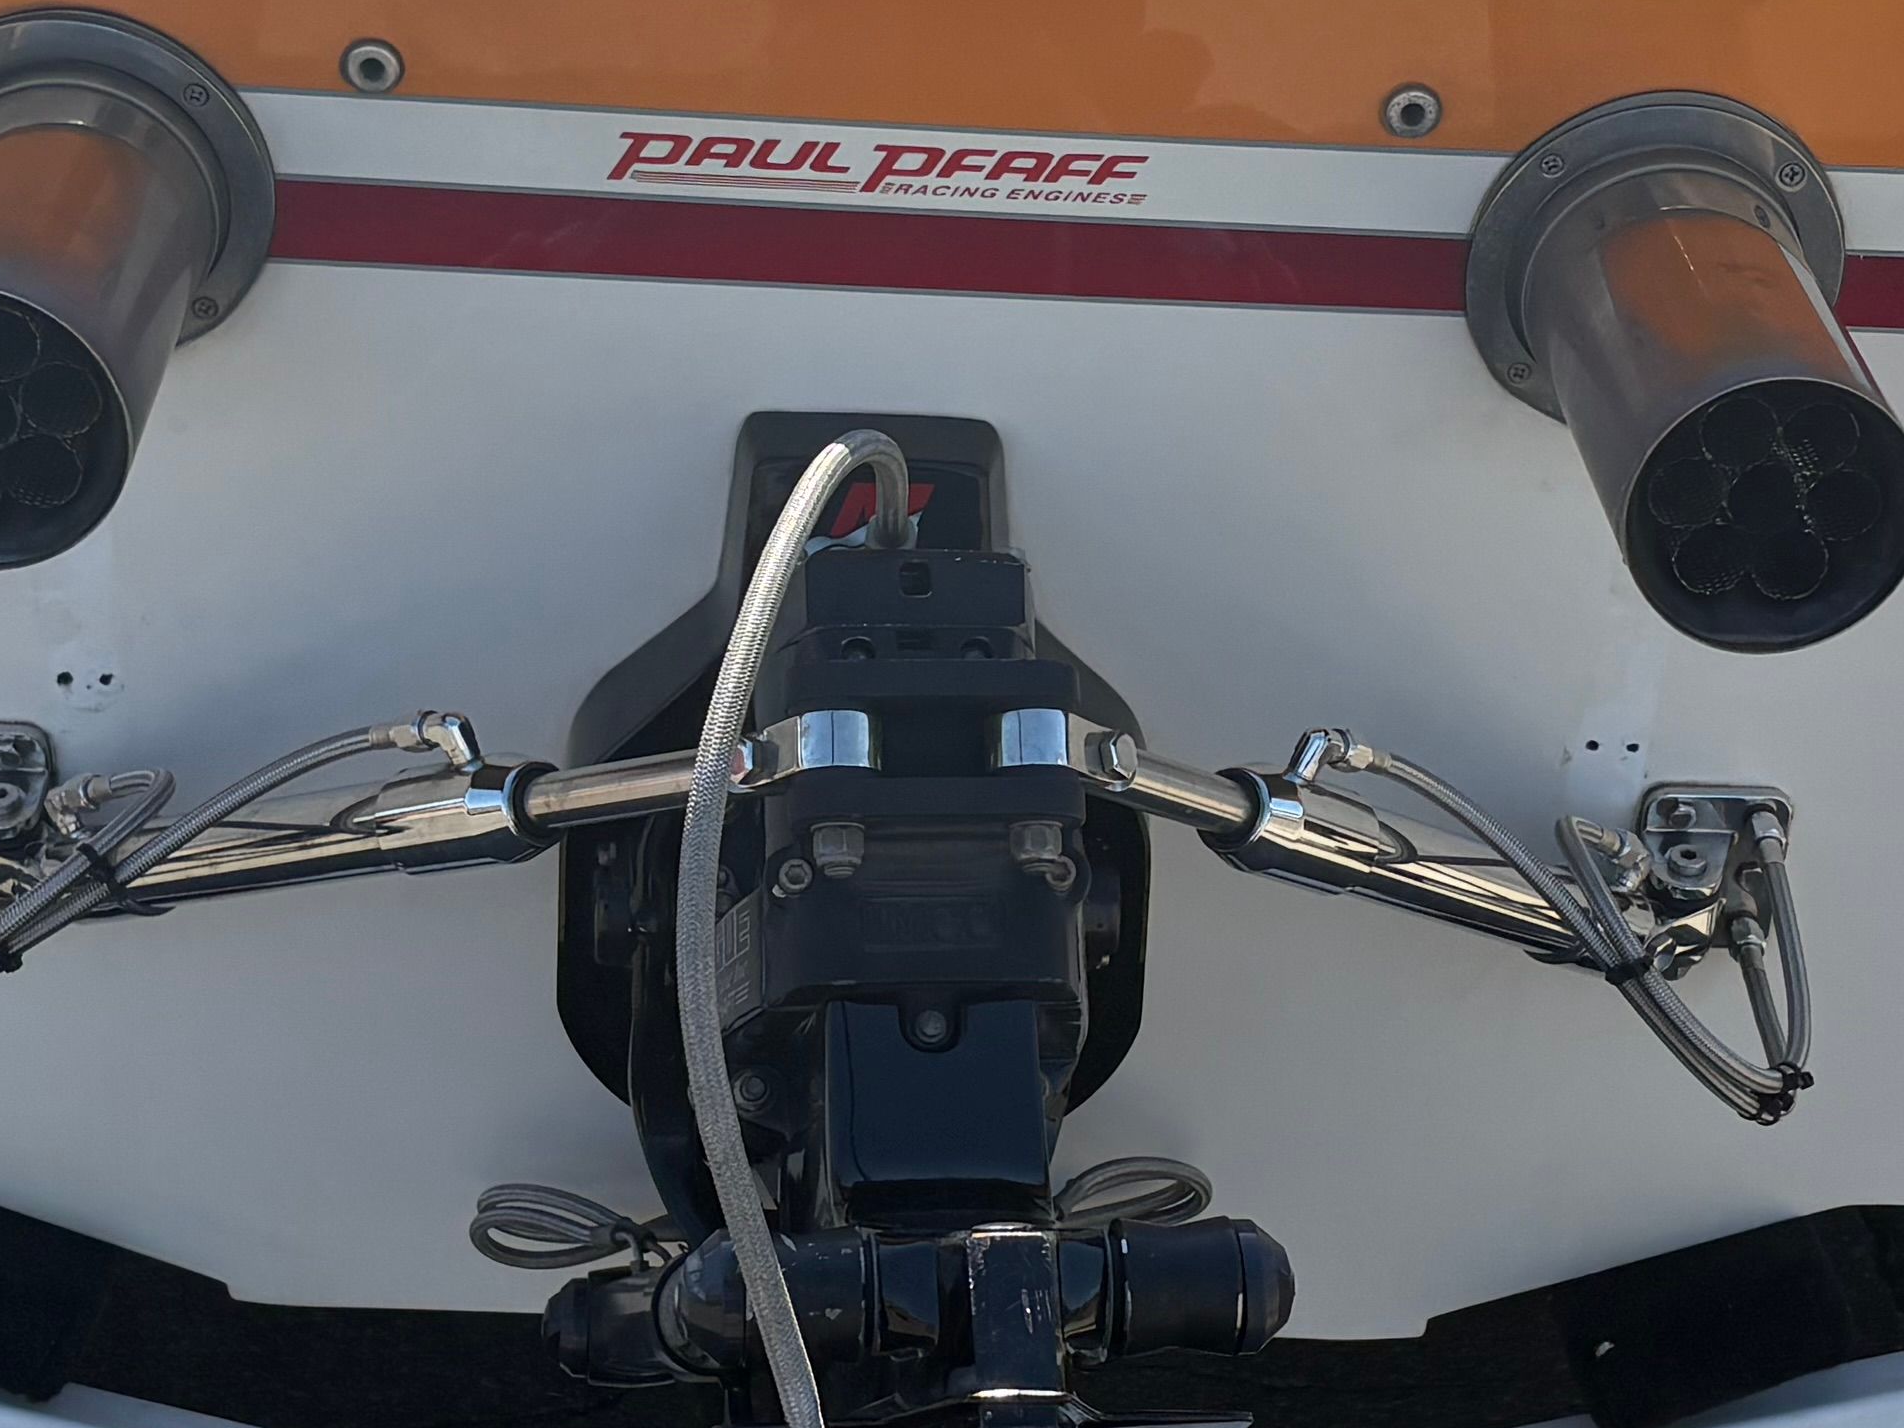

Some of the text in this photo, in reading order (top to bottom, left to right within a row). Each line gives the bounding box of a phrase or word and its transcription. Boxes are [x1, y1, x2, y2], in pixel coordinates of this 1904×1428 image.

[606, 131, 1150, 193] PAUL PFAFF
[893, 183, 1128, 205] RACING ENGINES
